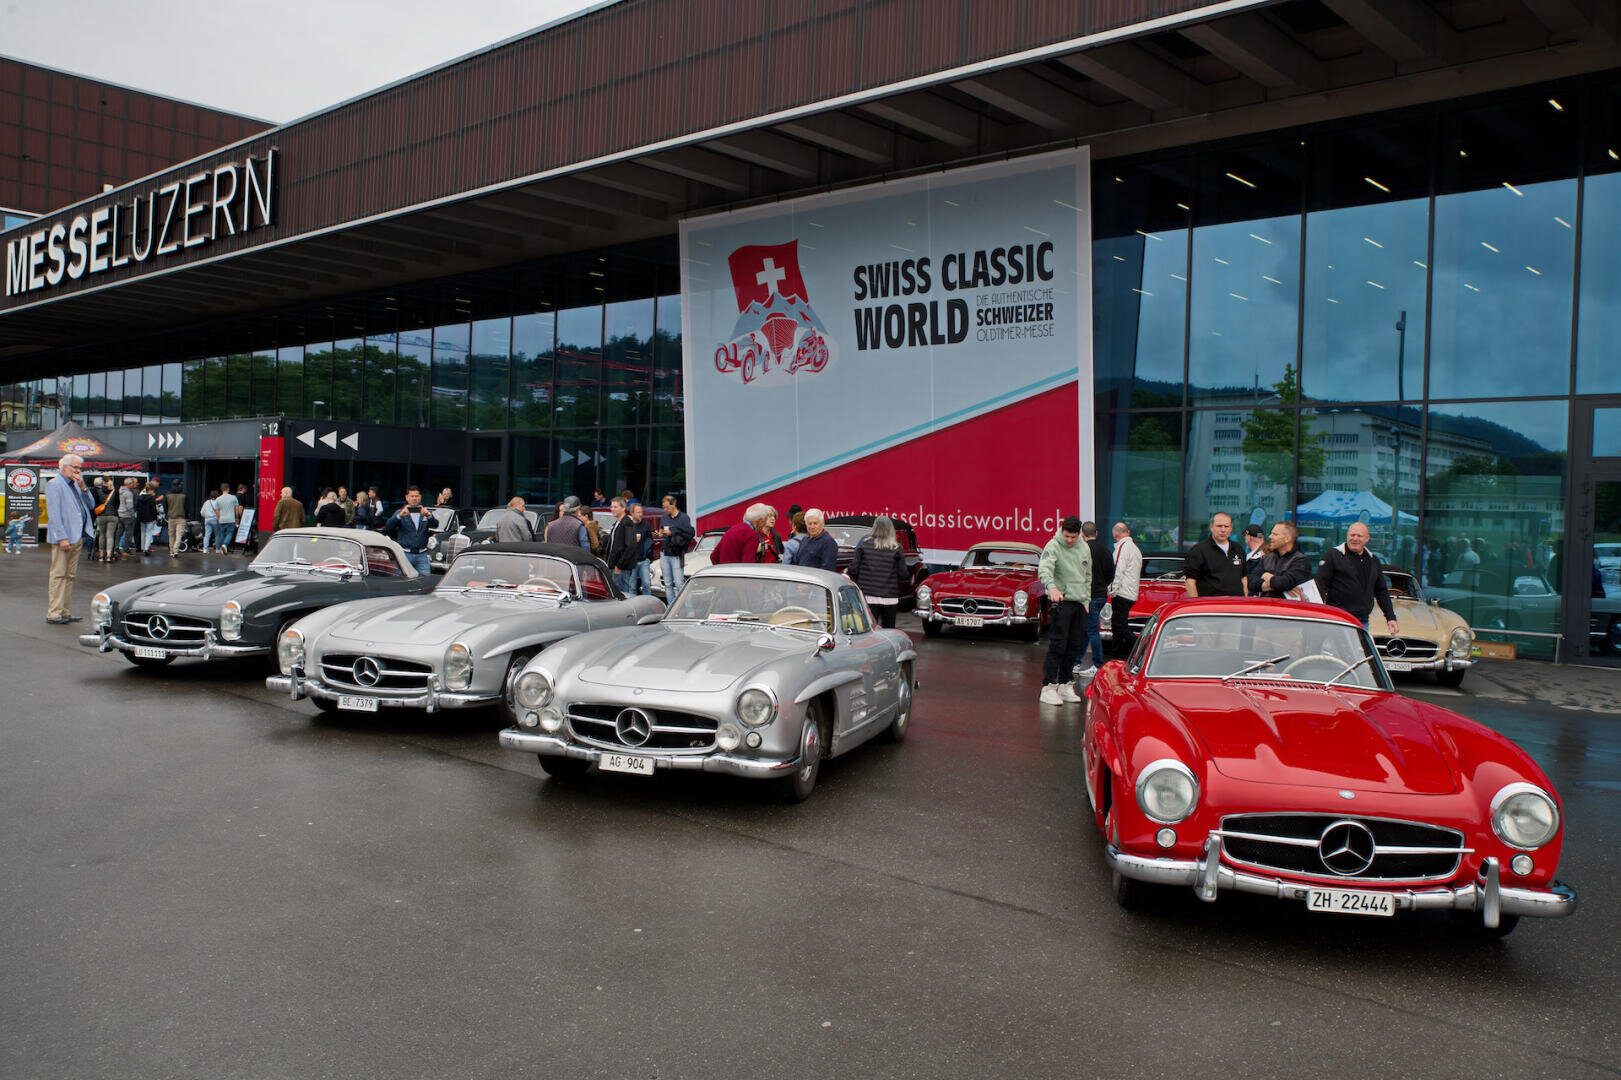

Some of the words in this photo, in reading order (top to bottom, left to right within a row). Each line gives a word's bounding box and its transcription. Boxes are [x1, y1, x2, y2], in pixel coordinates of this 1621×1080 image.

[853, 256, 932, 301] SWISS
[941, 241, 1055, 292] CLASSIC
[976, 294, 989, 306] DIE
[991, 287, 1054, 305] AUTHENTISCHE
[854, 297, 970, 351] WORLD
[976, 301, 1055, 327] SCHWEIZER
[976, 322, 1055, 343] OLDTIMER-MESSE
[268, 421, 279, 435] 12
